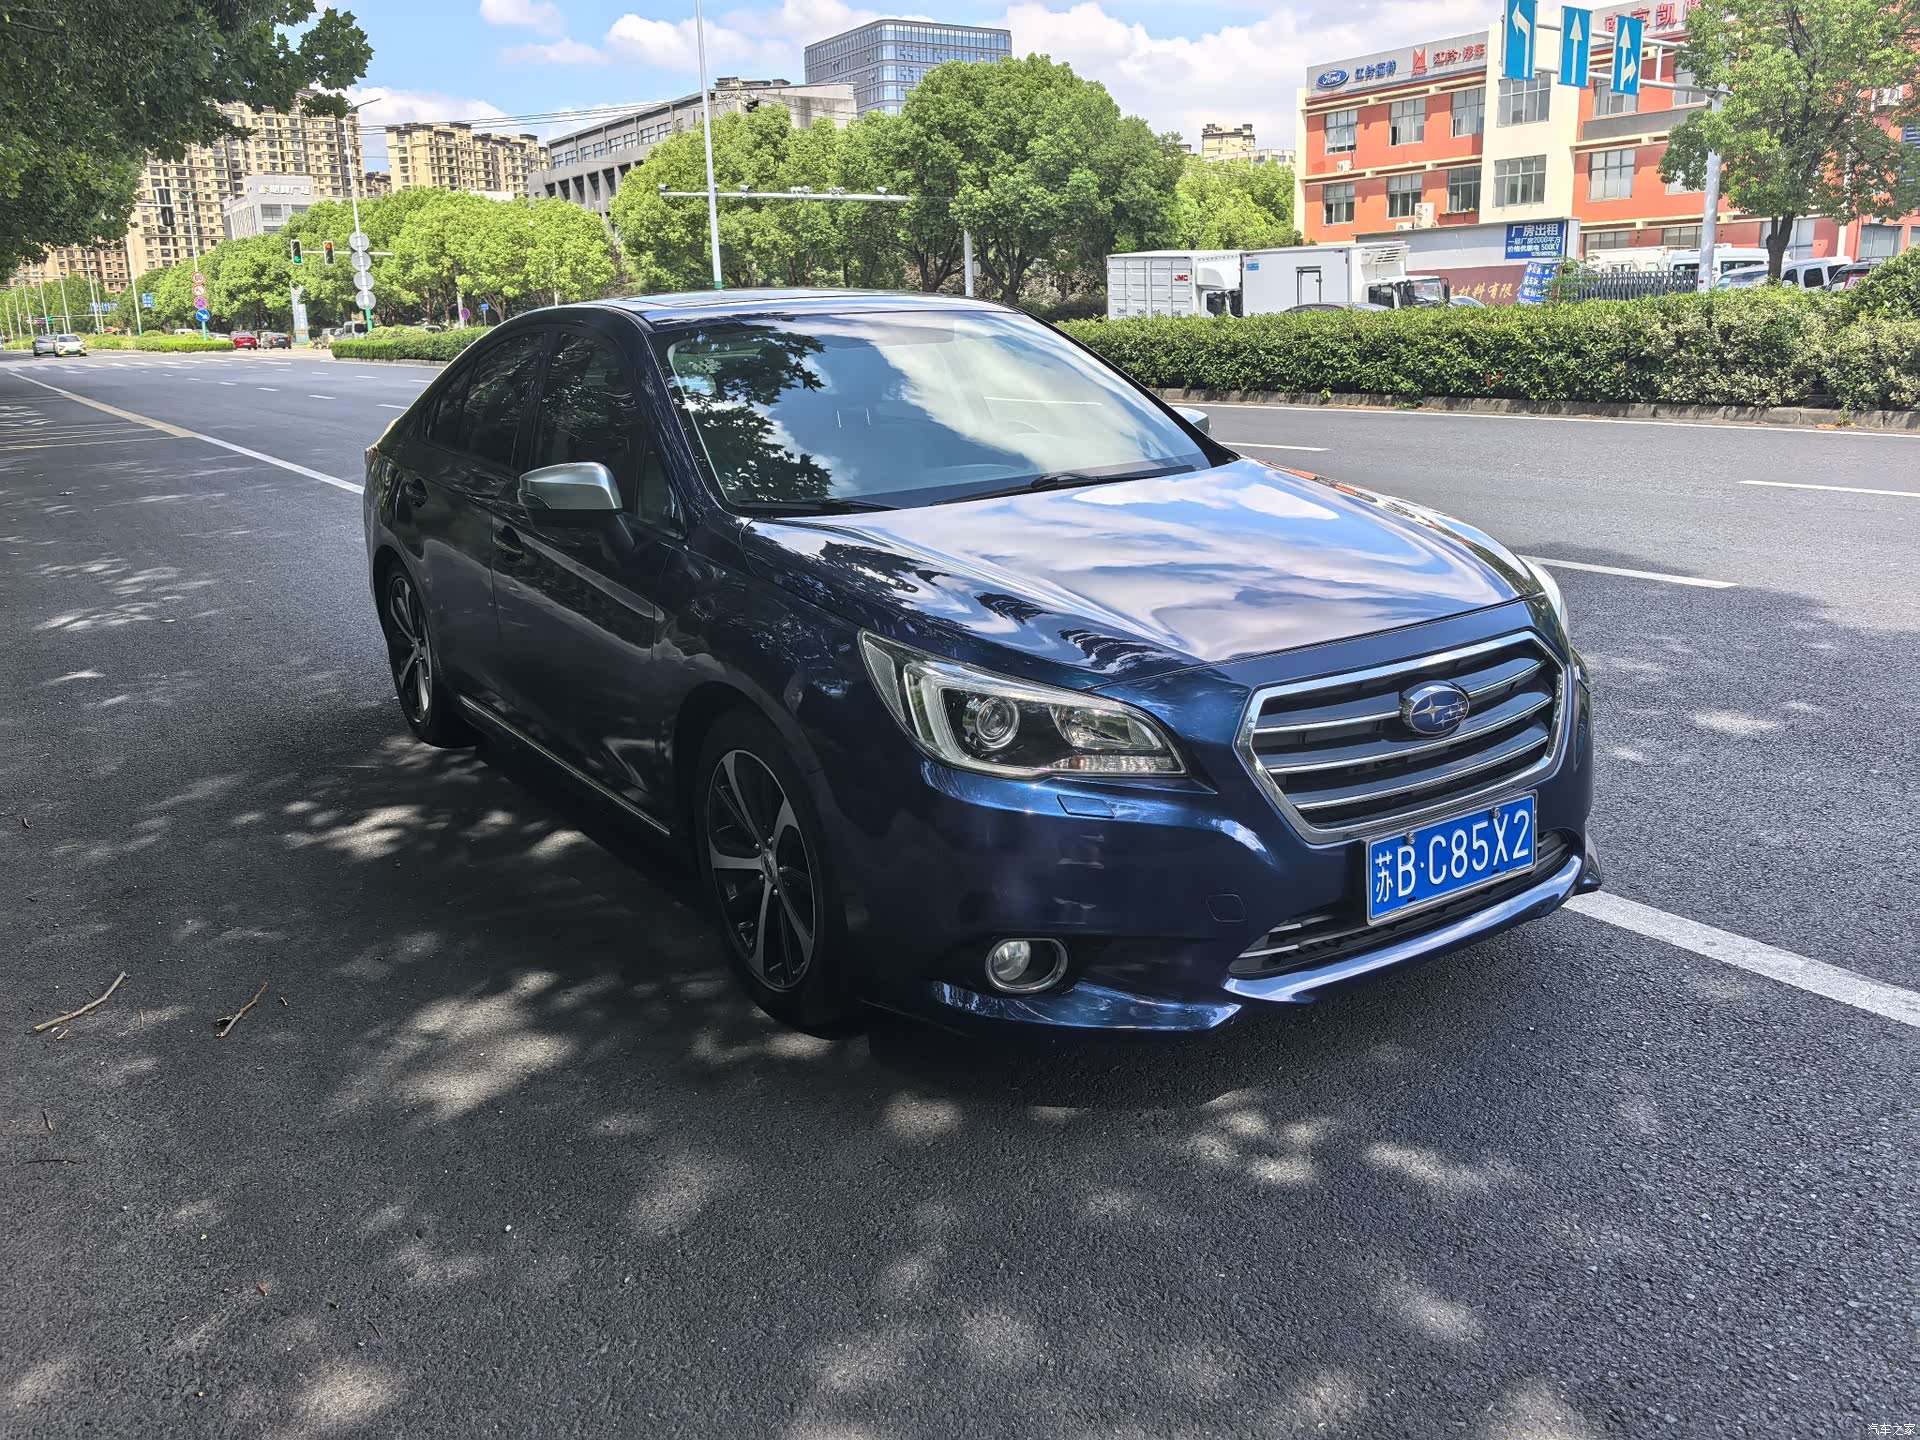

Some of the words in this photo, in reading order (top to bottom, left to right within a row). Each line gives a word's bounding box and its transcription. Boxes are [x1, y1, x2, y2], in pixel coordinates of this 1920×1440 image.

[1511, 223, 1559, 237] 厂房出租
[1174, 274, 1189, 282] JMC
